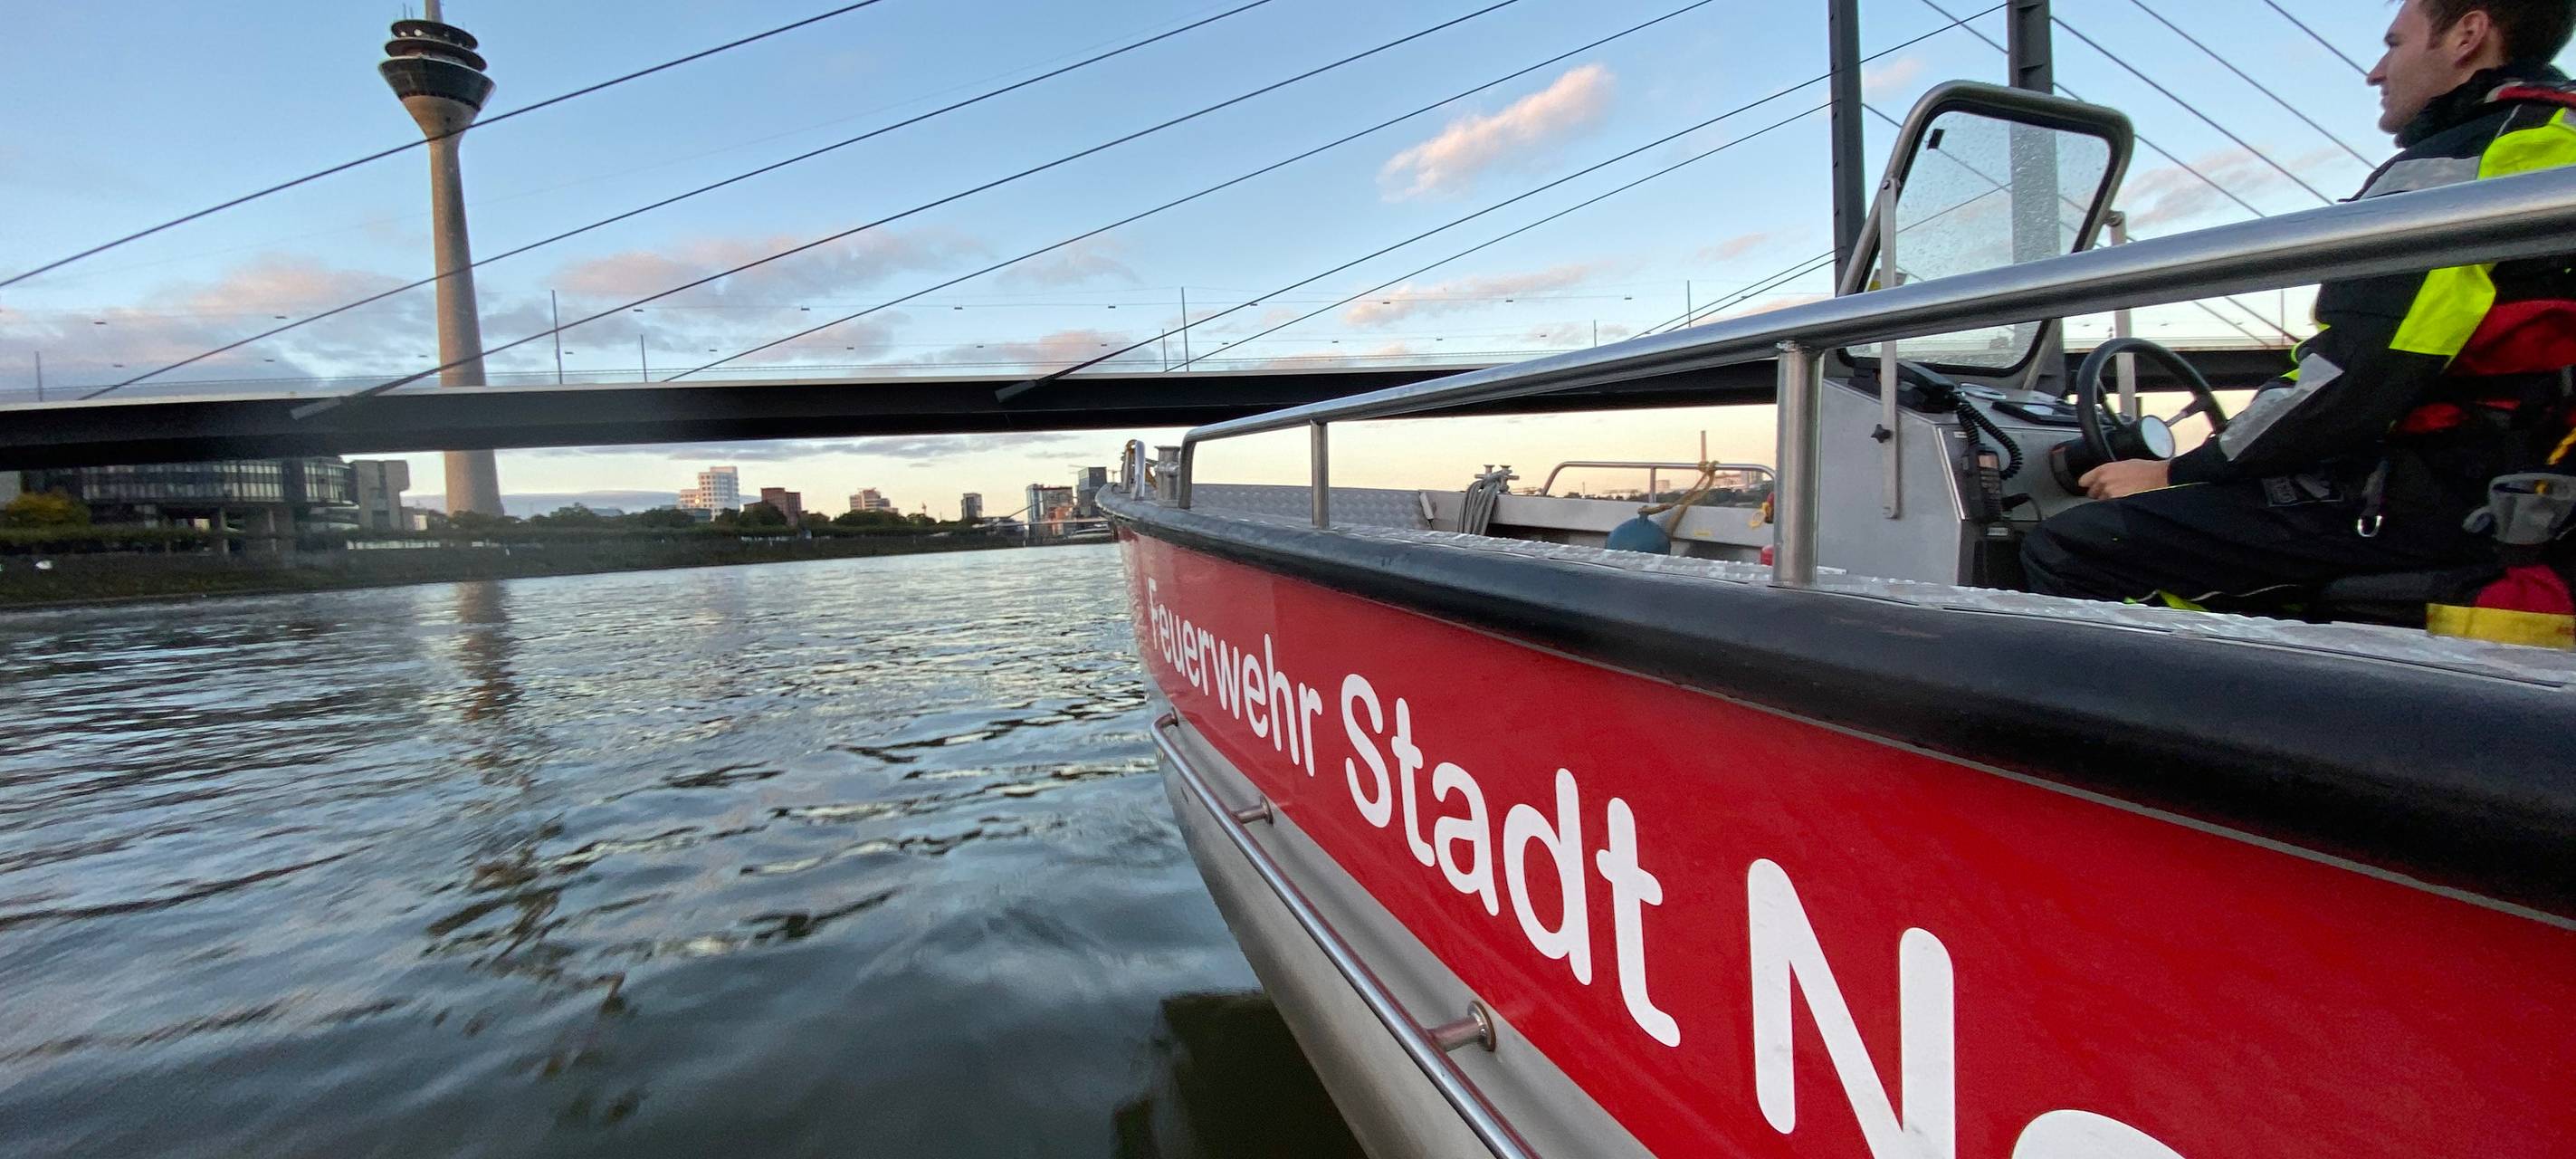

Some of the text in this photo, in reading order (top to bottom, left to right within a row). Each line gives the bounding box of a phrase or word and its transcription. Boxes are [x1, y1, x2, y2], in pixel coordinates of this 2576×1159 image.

[1147, 576, 2186, 1159] Feuerwehr Stadt N
